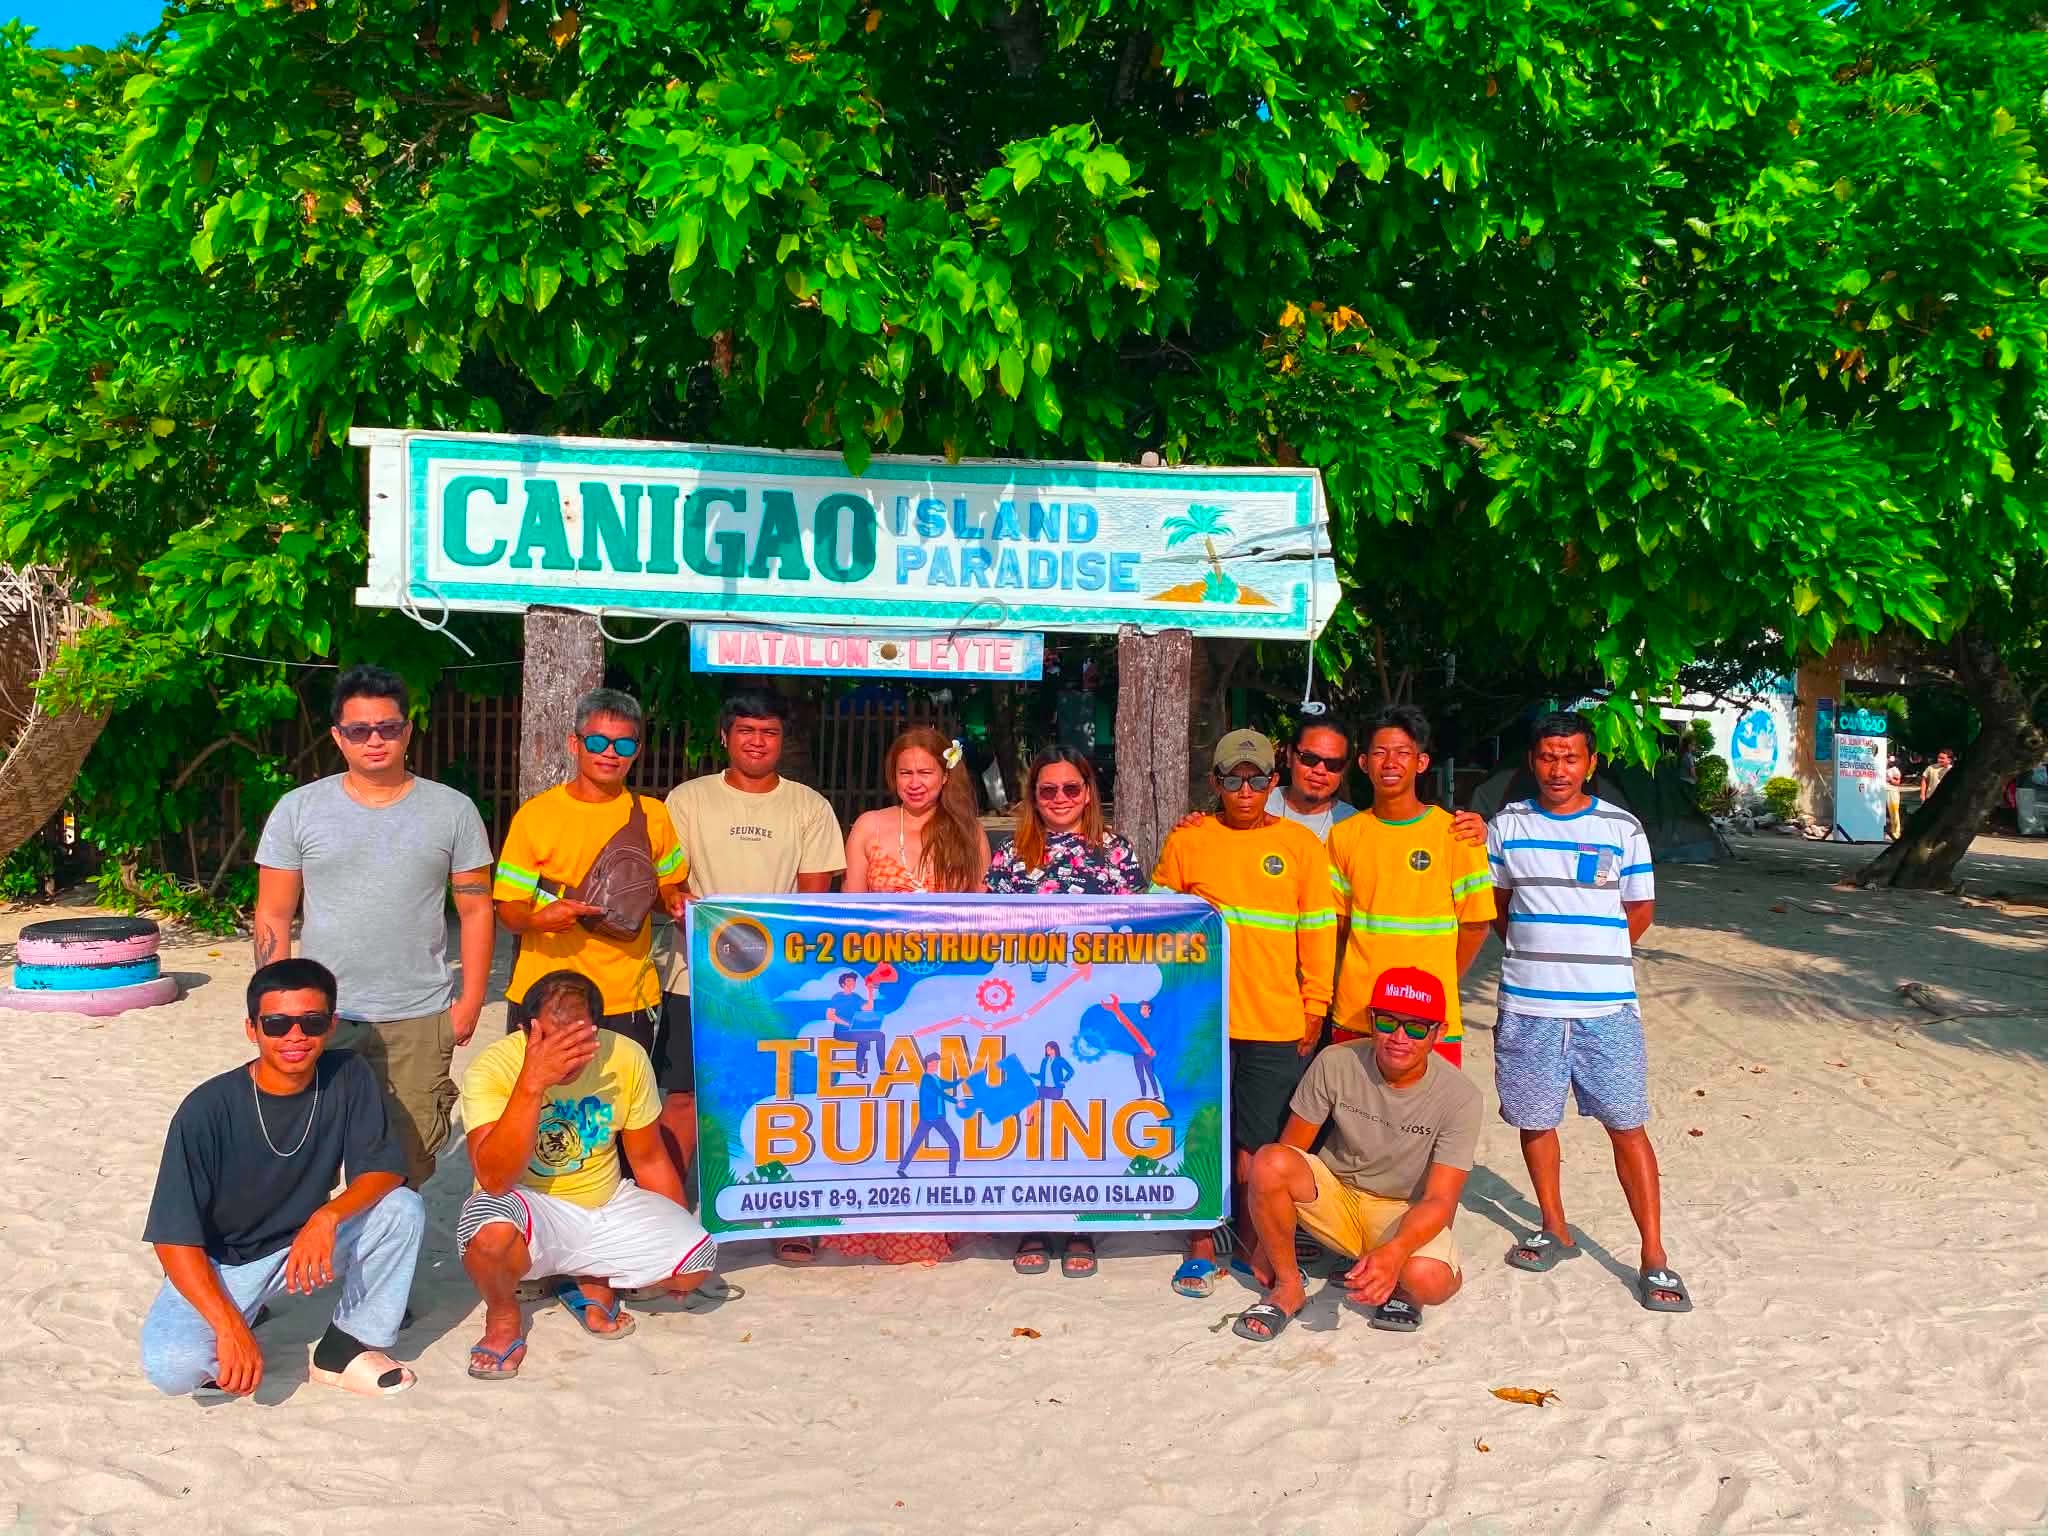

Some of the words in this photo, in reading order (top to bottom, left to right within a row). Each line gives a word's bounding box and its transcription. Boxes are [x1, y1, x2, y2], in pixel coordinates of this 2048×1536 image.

[442, 475, 877, 583] CANIGAO
[896, 495, 1099, 544] ISLAND
[896, 544, 1142, 592] PARADISE
[908, 636, 1014, 672] LEYTE
[784, 932, 835, 964] G-2
[842, 931, 1068, 965] CONSTRUCTION
[1072, 931, 1208, 965] SERVICES
[1384, 983, 1432, 1004] Marlboro
[757, 1034, 1007, 1102] TEAM
[741, 1189, 824, 1212] AUGUST
[829, 1188, 862, 1209] 8-9,
[868, 1186, 911, 1206] 2026
[926, 1185, 976, 1205] HELD
[981, 1185, 1006, 1204] AT
[1011, 1184, 1100, 1204] CANIGAO
[1105, 1183, 1175, 1203] ISLAND
